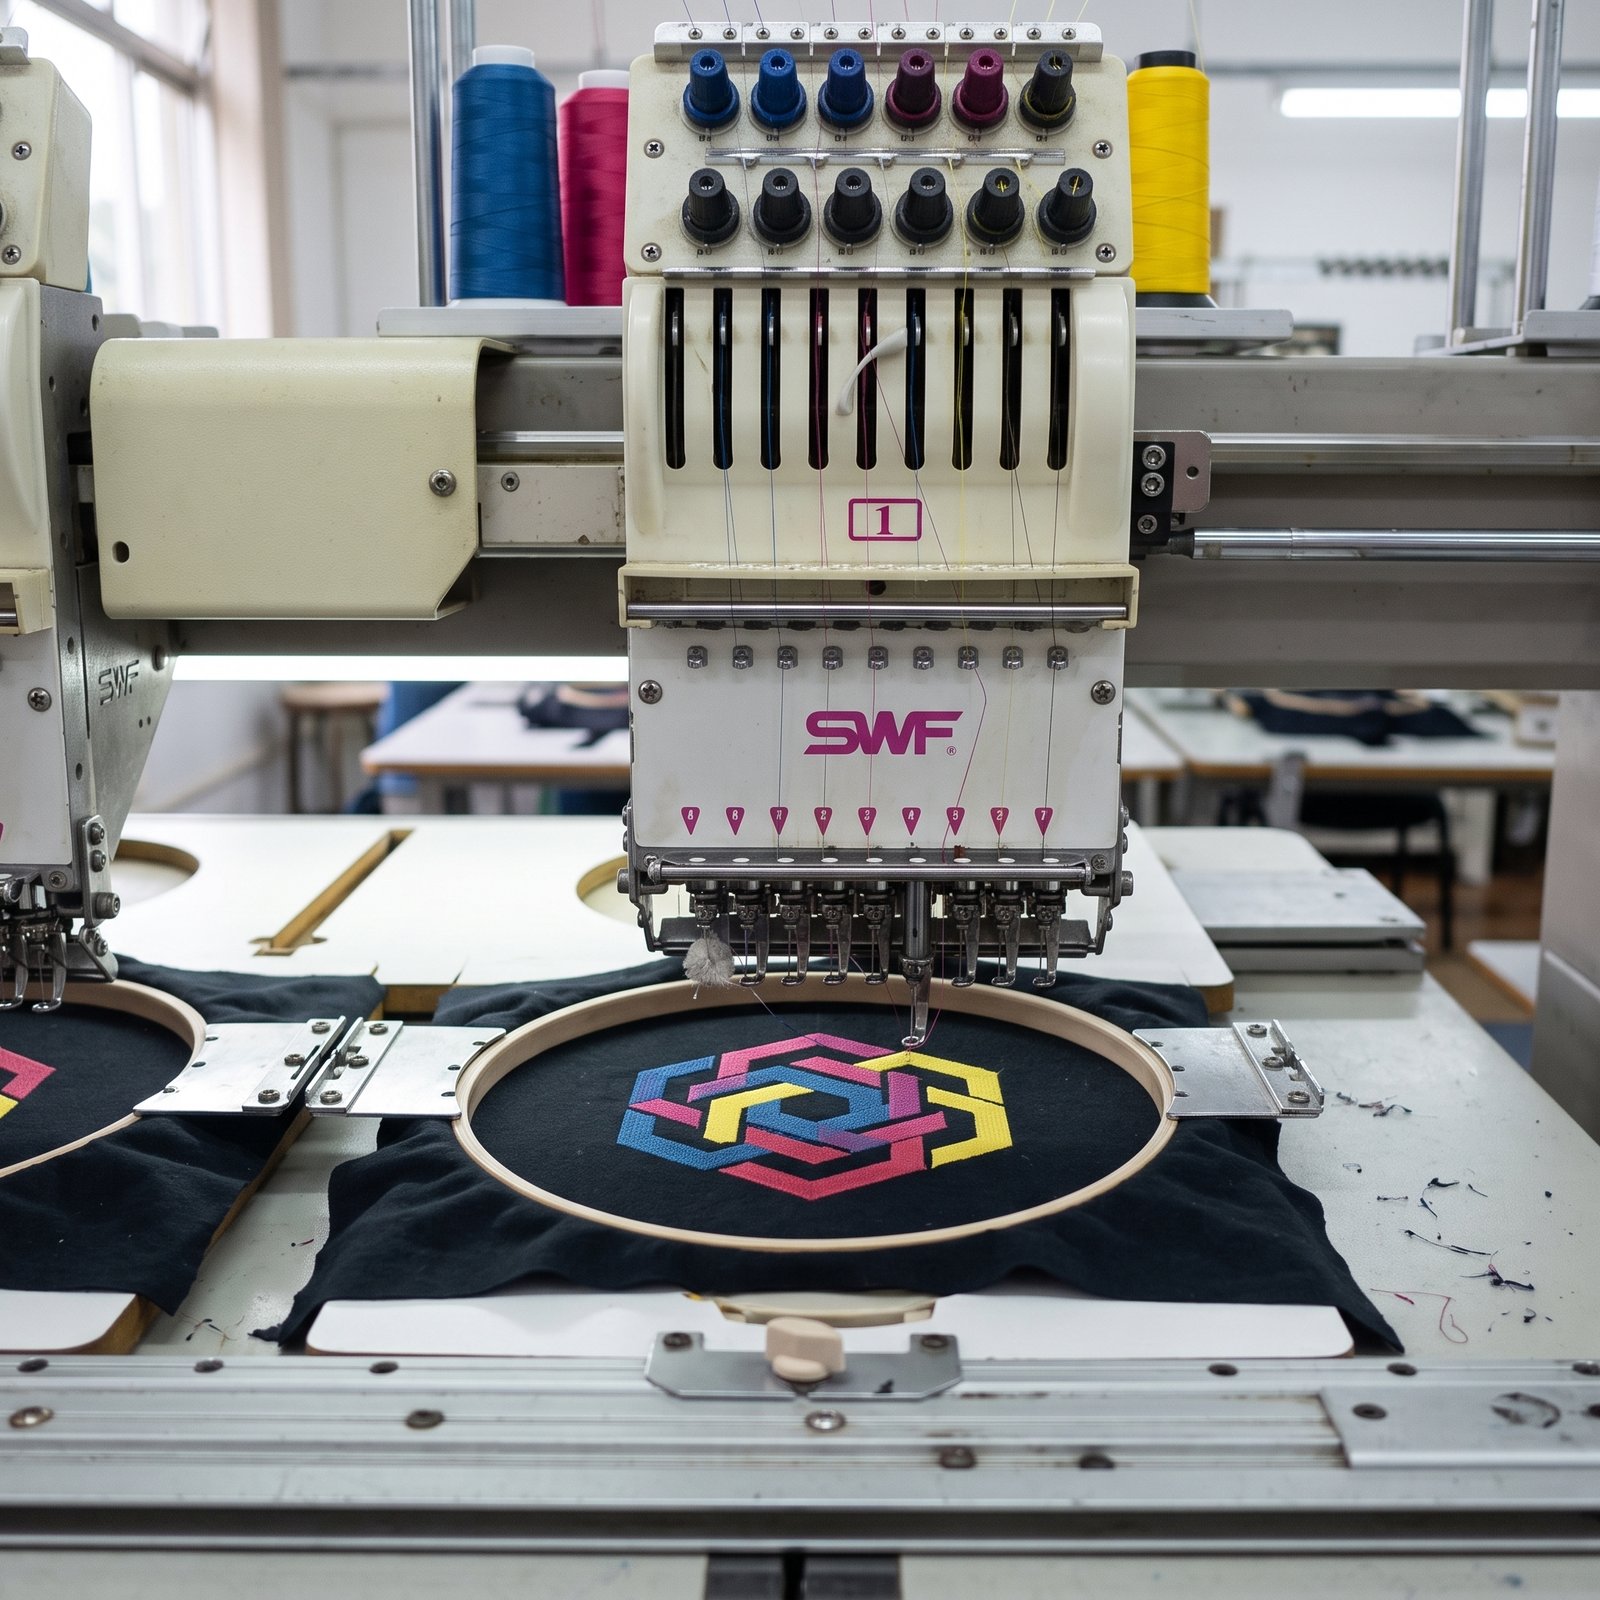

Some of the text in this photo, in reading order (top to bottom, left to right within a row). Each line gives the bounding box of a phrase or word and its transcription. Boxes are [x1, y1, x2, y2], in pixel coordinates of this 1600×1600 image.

[875, 505, 893, 535] 1
[98, 659, 140, 706] SWF
[803, 710, 964, 755] SWF
